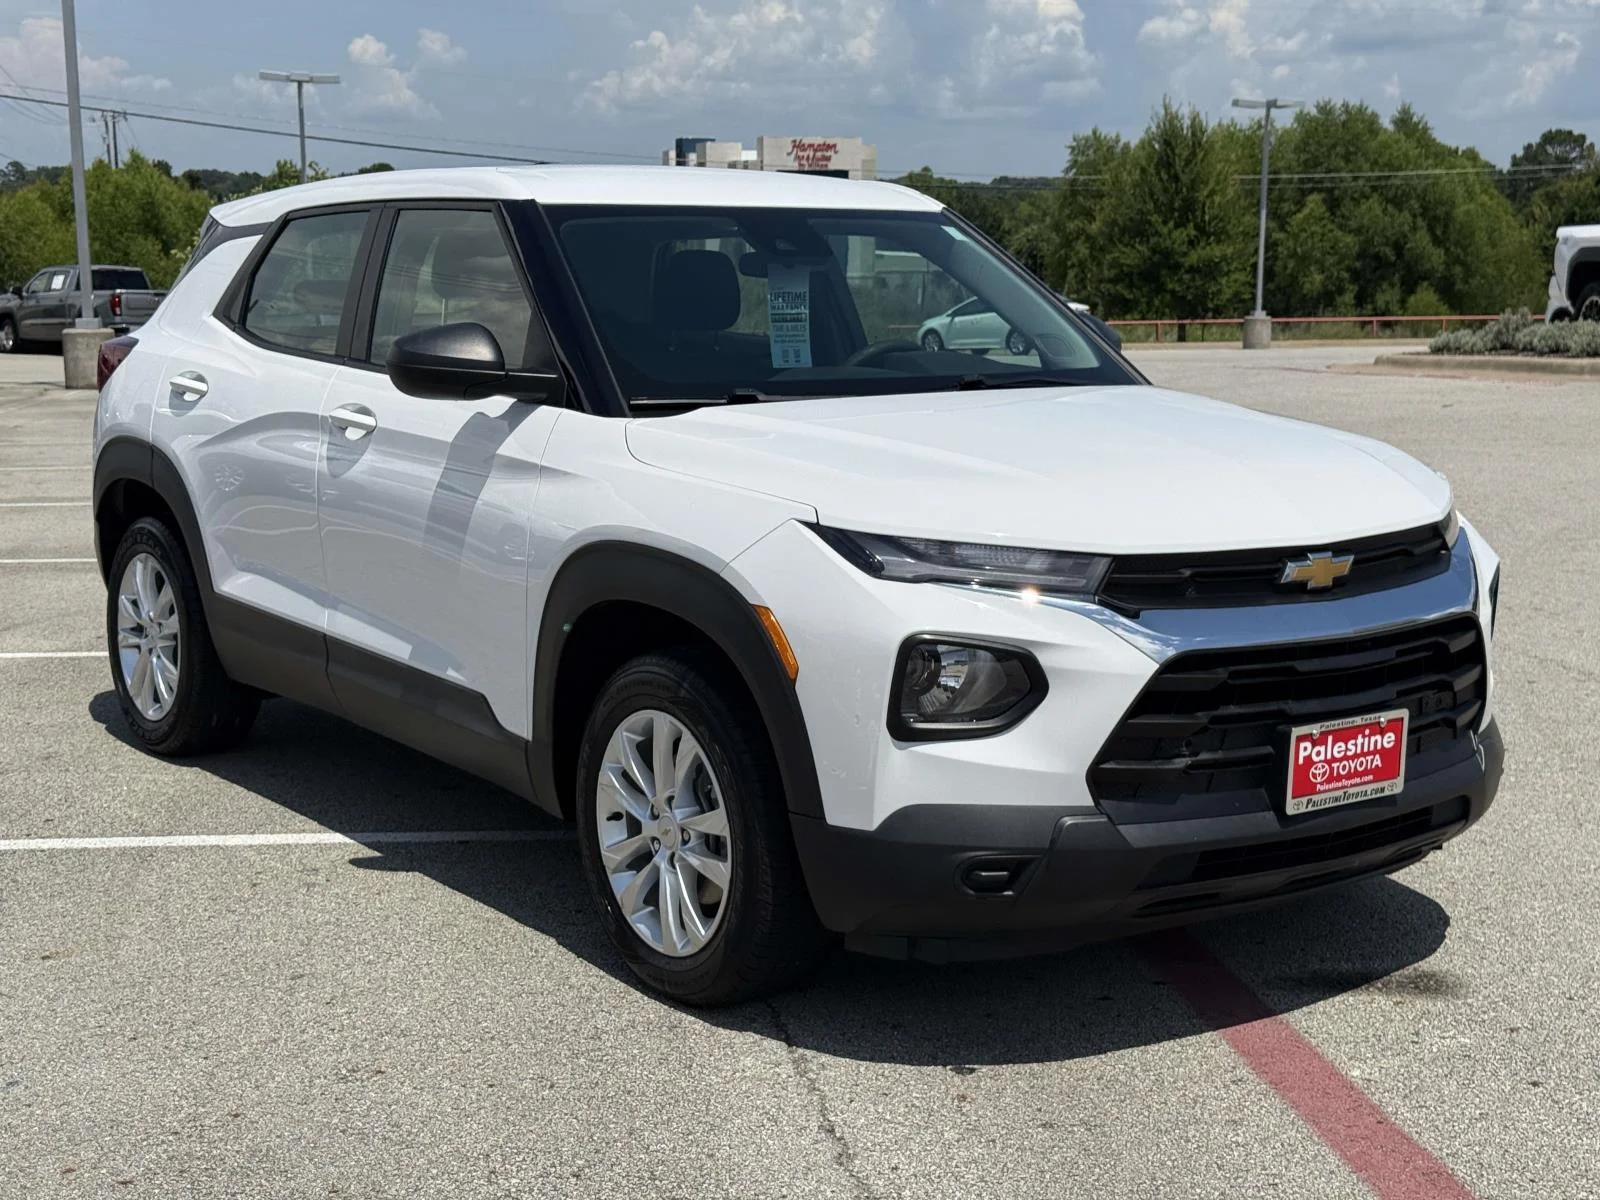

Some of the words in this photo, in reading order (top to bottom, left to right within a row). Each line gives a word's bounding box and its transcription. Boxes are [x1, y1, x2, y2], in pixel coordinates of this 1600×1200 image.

[786, 139, 838, 155] Hampton
[769, 291, 807, 303] LIFETIME
[1298, 729, 1396, 765] Palestine
[1331, 754, 1382, 777] TOYOTA
[1316, 774, 1374, 792] PalestineToyota.com
